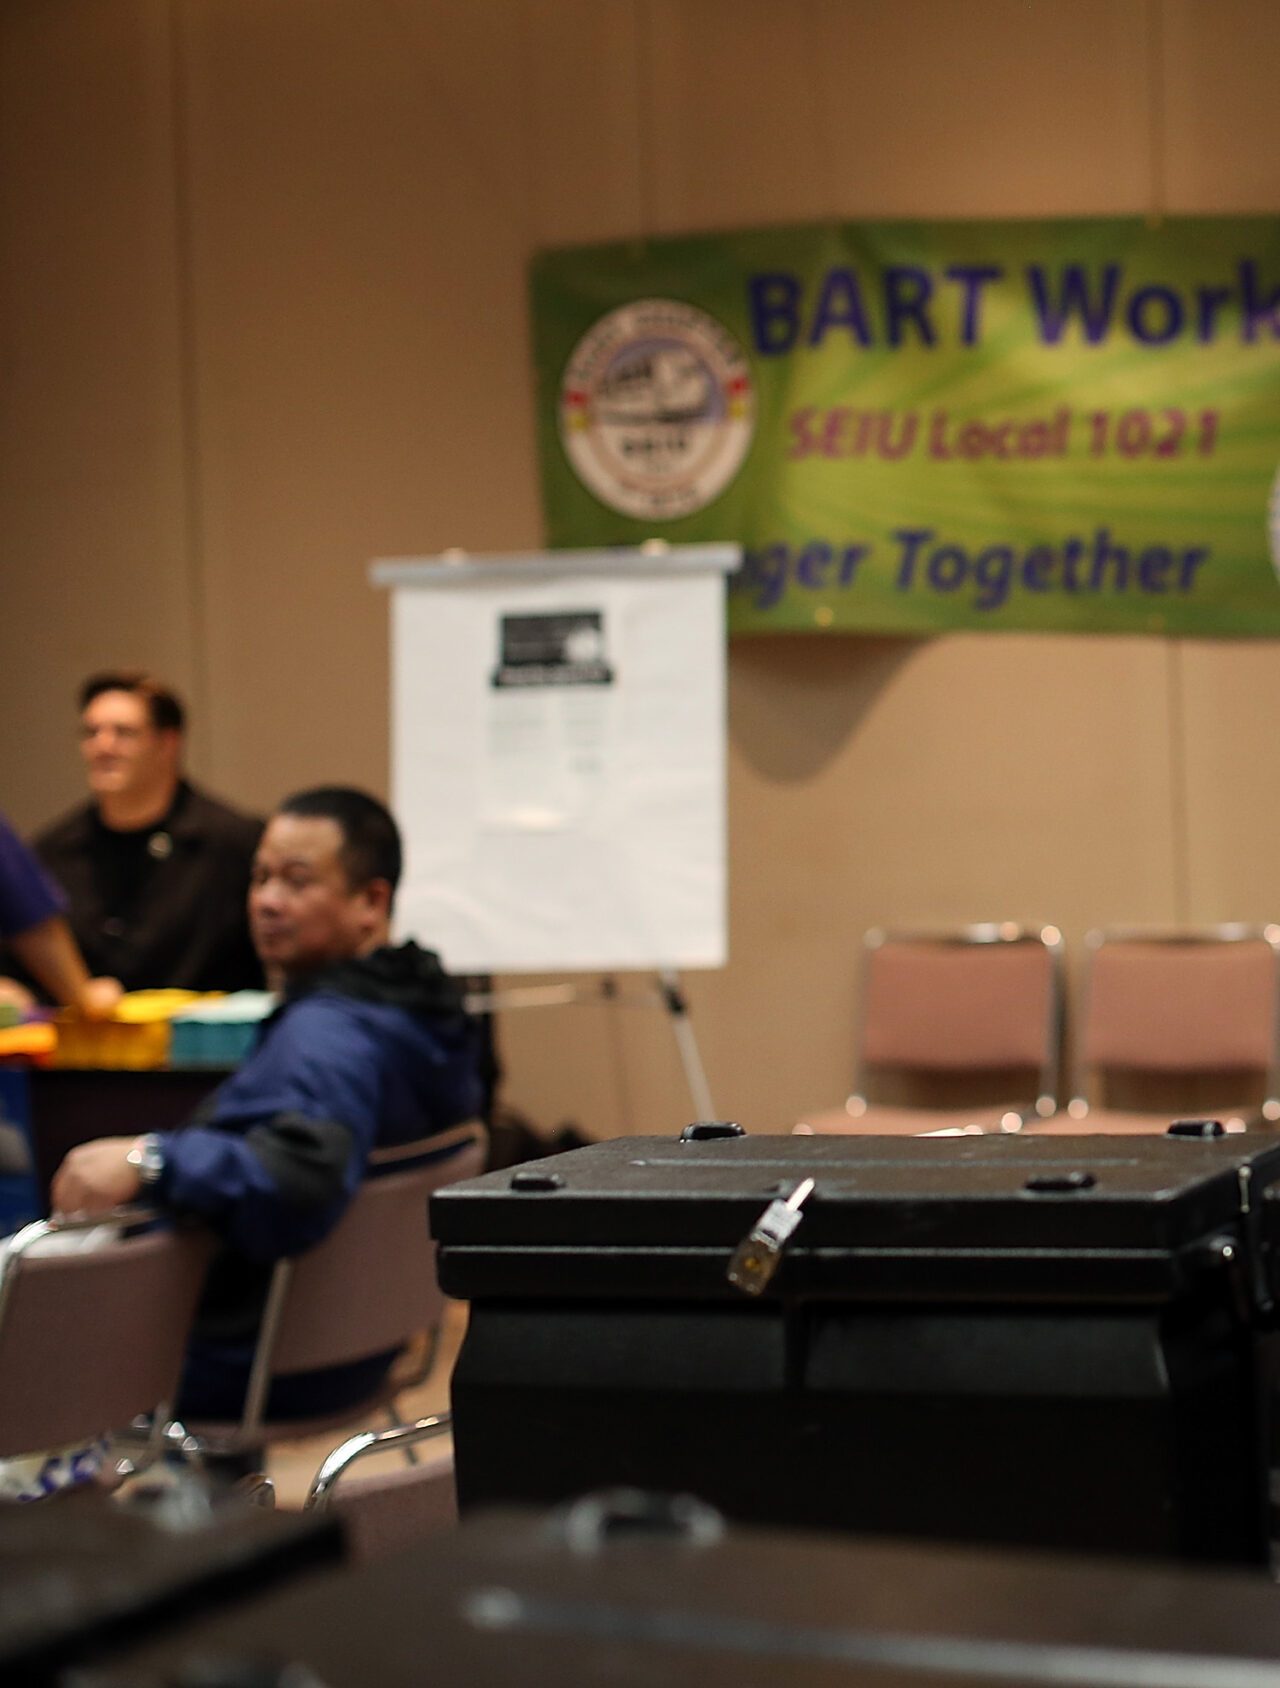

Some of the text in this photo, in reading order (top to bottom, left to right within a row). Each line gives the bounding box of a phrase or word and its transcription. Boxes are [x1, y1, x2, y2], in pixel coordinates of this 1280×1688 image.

[747, 264, 1004, 355] BART
[786, 402, 1220, 461] SEIU Local 1021
[894, 526, 1212, 610] Together
